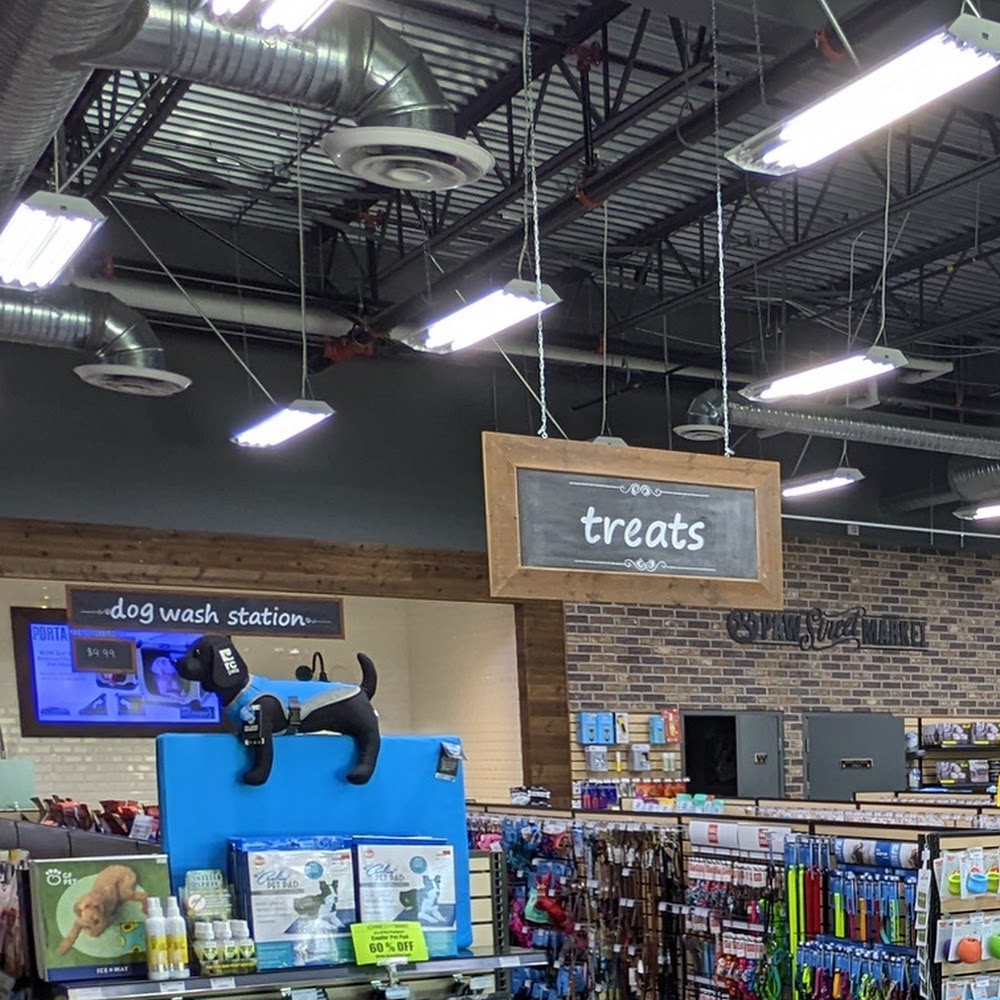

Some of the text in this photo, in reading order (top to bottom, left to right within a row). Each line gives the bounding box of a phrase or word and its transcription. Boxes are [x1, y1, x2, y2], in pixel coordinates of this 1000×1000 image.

[580, 505, 706, 552] treats
[110, 597, 306, 627] dog wash station
[32, 626, 68, 641] PORTA
[761, 607, 928, 650] PAW Street MARKET
[63, 878, 77, 886] PET
[284, 880, 300, 889] PAD
[389, 873, 405, 882] PAD
[369, 942, 384, 954] 60
[397, 941, 414, 952] OFF
